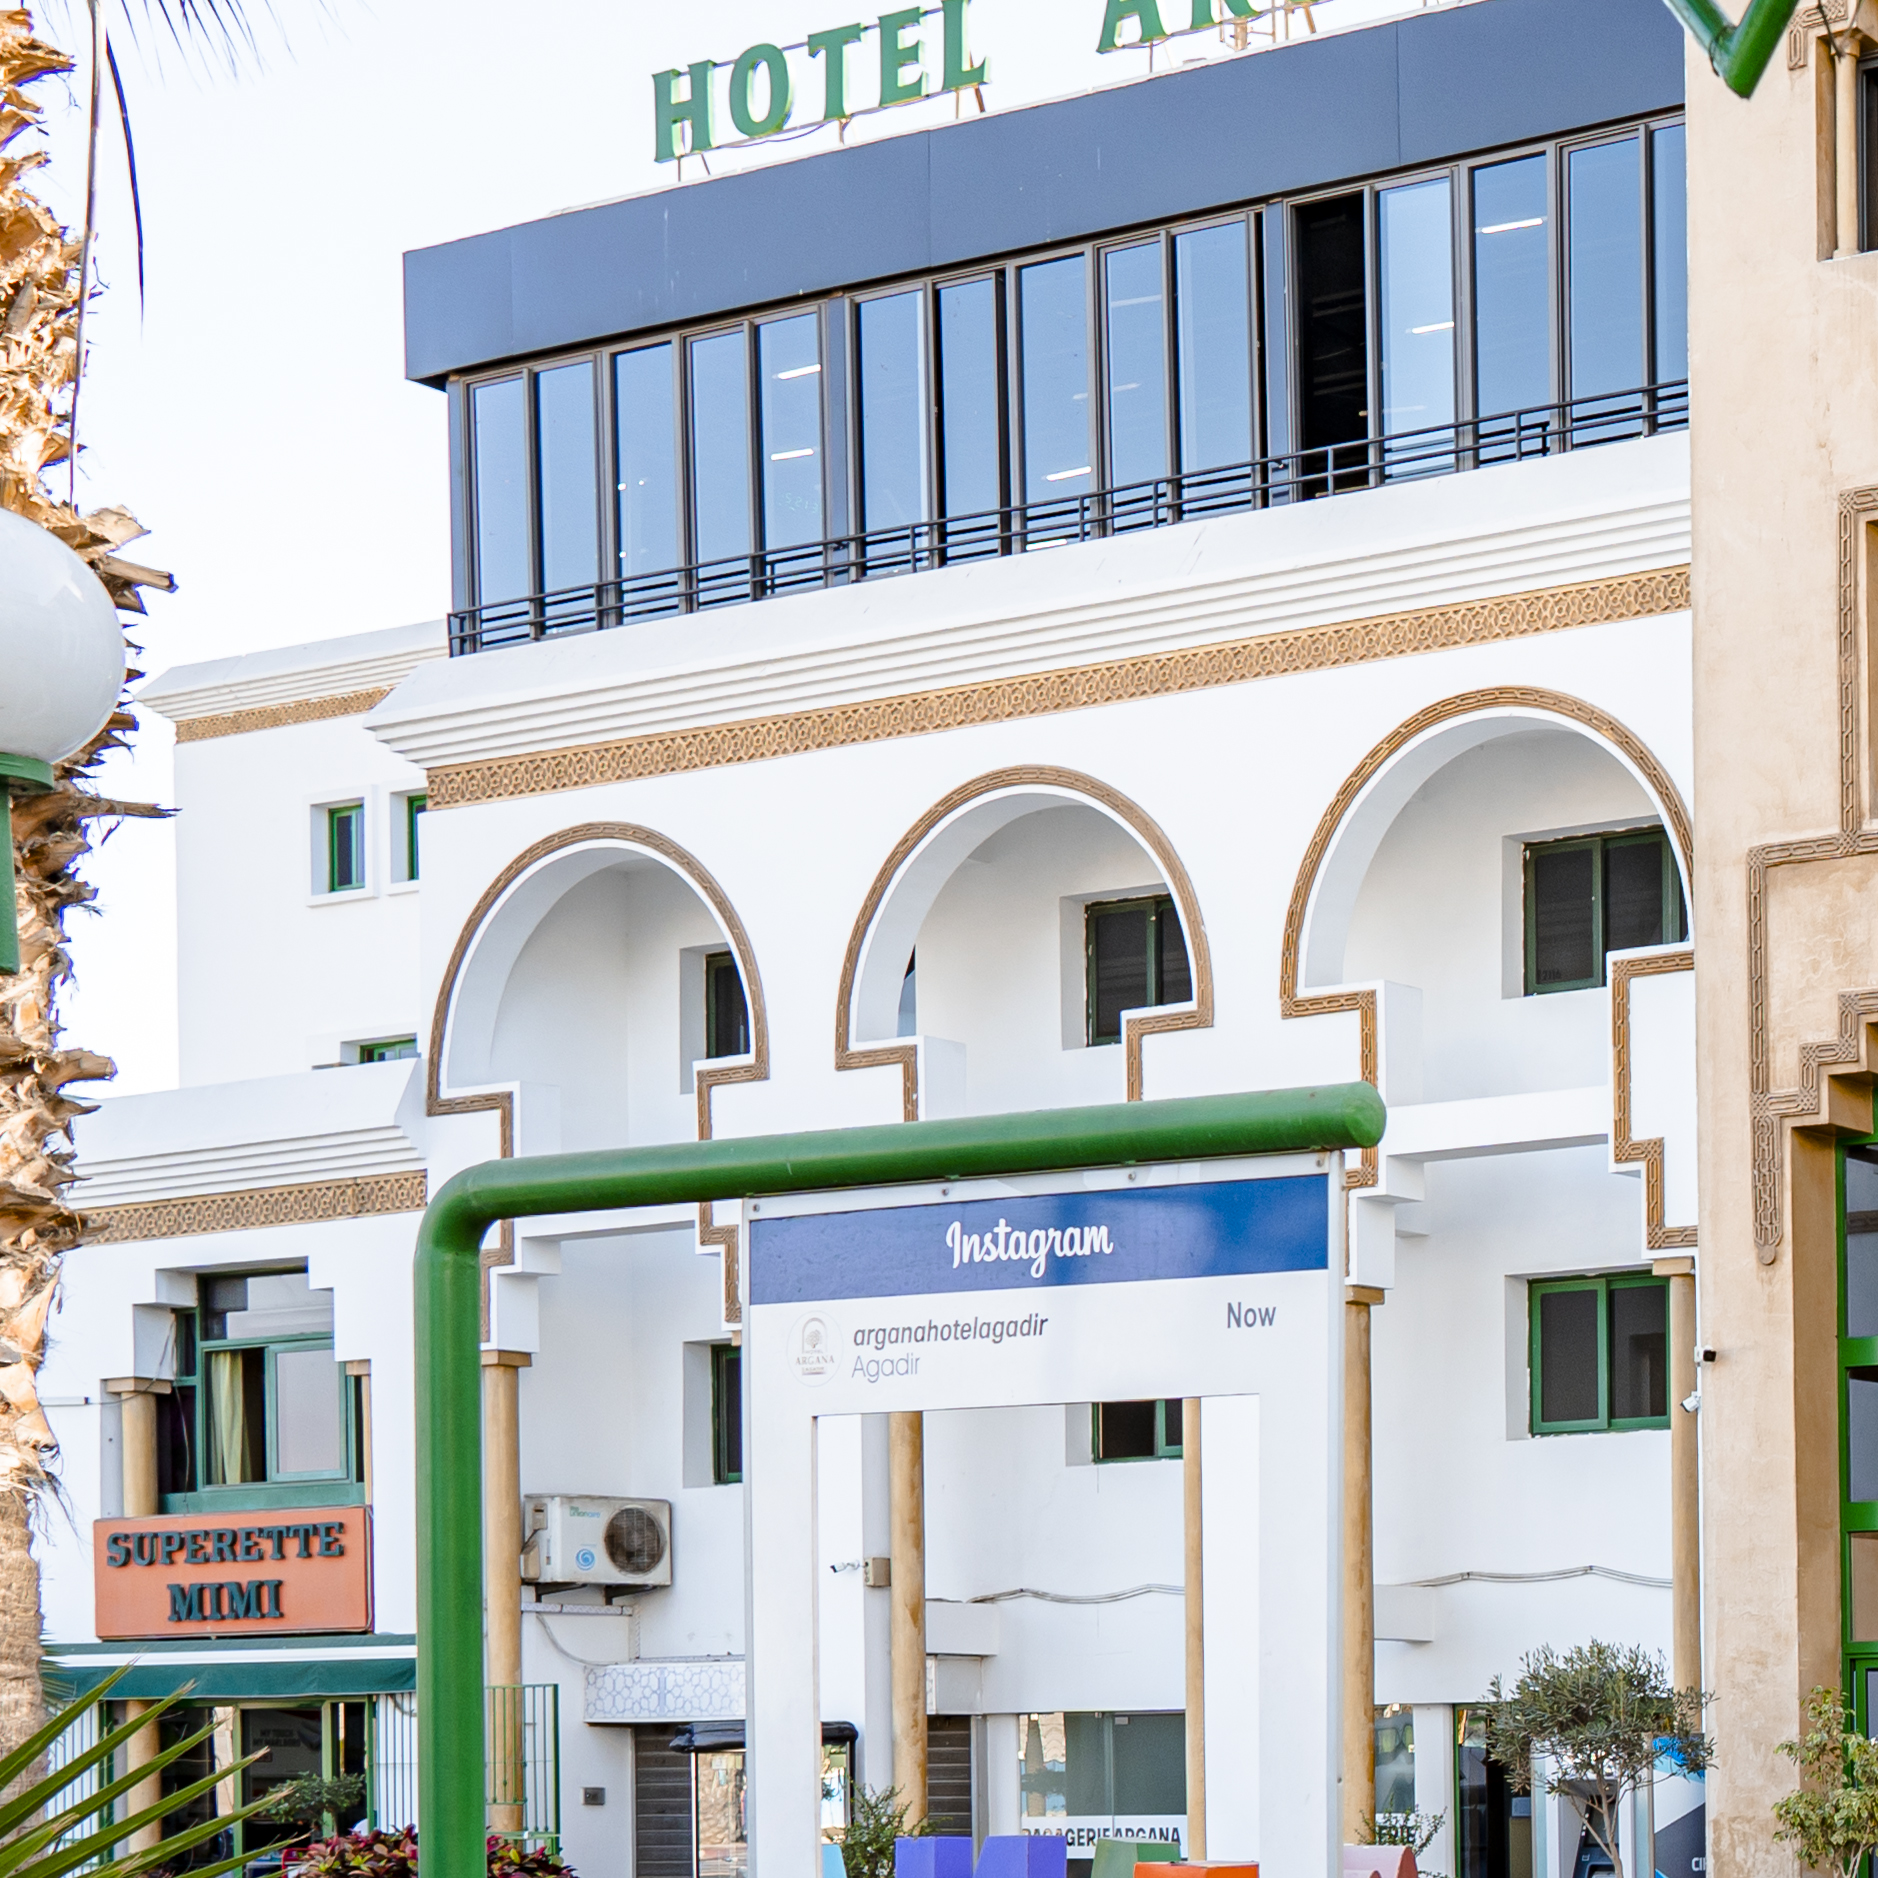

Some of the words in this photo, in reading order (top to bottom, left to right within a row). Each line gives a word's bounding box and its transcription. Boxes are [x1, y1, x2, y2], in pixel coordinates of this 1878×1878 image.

[650, 0, 992, 163] HOTEL
[945, 1218, 1114, 1278] Instagram
[853, 1313, 1048, 1353] arganahotelagadir
[1226, 1302, 1277, 1329] Now
[795, 1354, 835, 1366] ARGANA
[852, 1353, 921, 1384] Agadir
[107, 1521, 345, 1567] SUPERETTE
[167, 1579, 284, 1622] MIMI
